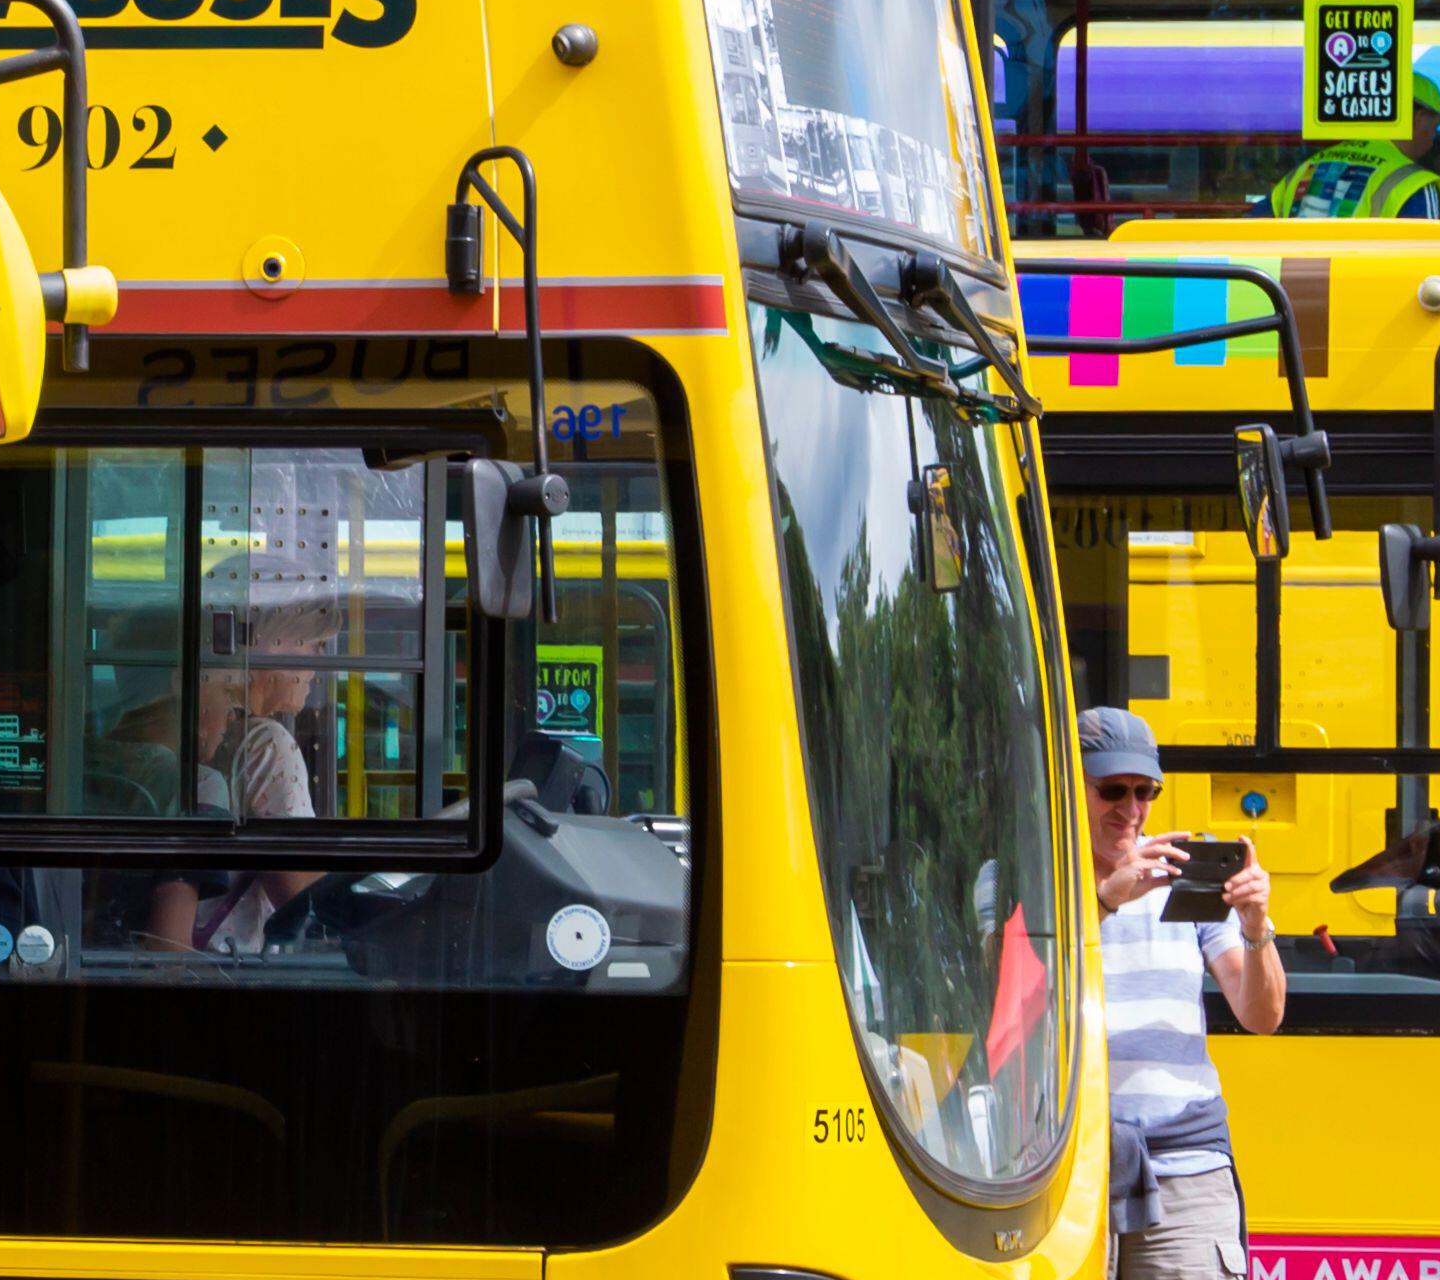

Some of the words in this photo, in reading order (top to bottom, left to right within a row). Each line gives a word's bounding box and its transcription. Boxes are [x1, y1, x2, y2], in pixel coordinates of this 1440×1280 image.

[1324, 10, 1350, 29] GET
[1355, 10, 1393, 29] FROM
[1324, 70, 1393, 97] SAFELY
[1342, 98, 1392, 118] EASILY
[813, 1108, 866, 1144] 5105
